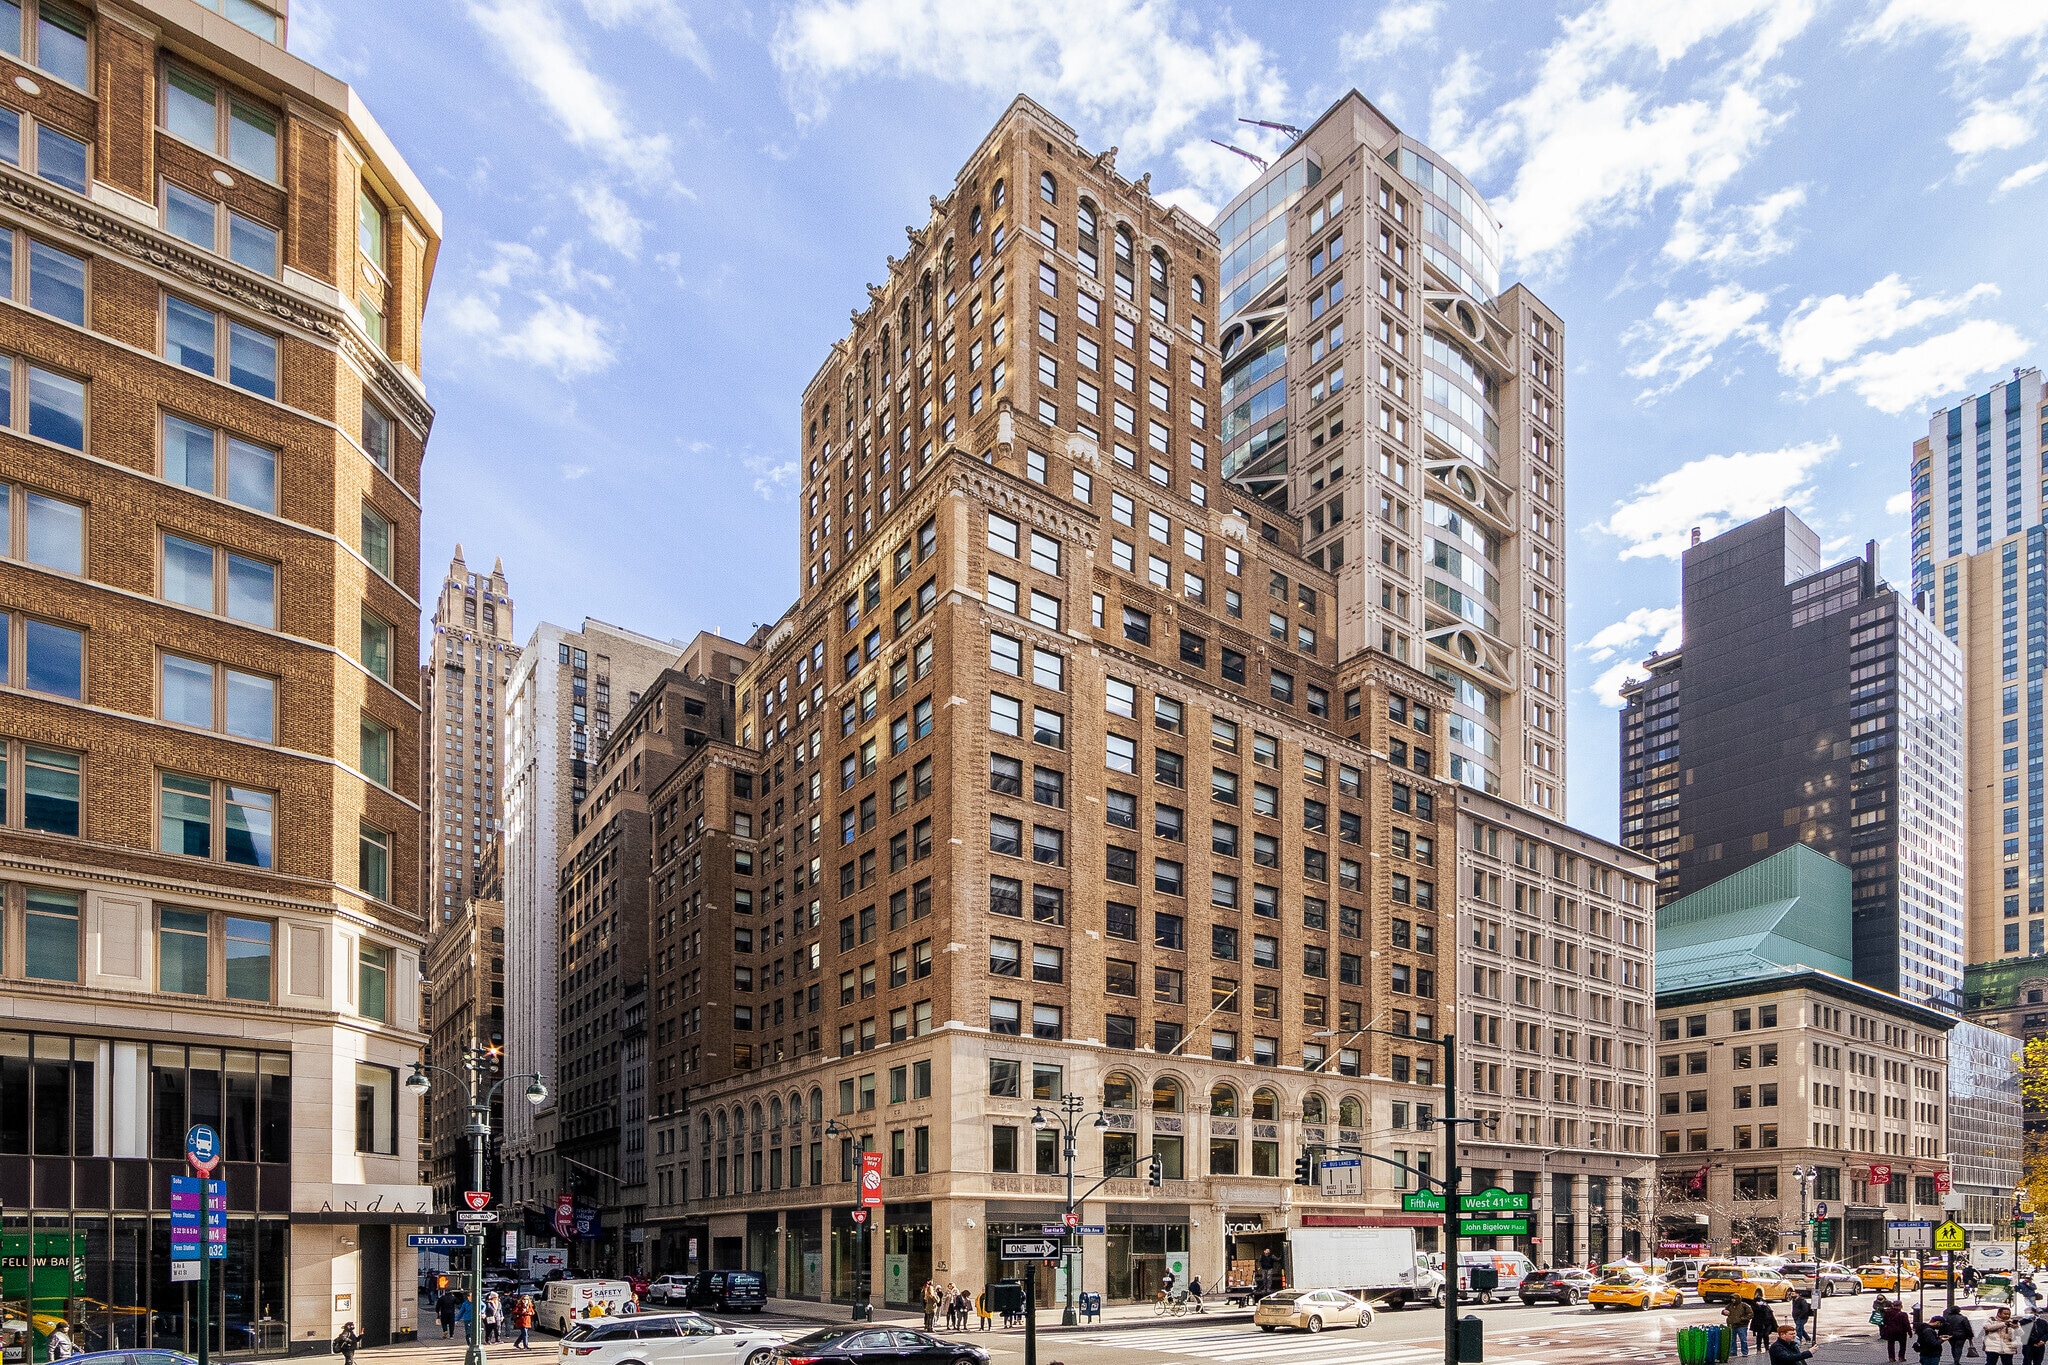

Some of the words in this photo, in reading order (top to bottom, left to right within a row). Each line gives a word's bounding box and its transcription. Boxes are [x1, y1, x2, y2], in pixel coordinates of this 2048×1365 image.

[1873, 1175, 1889, 1183] 125
[209, 1183, 218, 1193] M1
[209, 1197, 219, 1209] M1
[1410, 1199, 1426, 1208] Fifth
[1427, 1199, 1440, 1208] Ave
[1465, 1198, 1490, 1208] West
[1492, 1197, 1510, 1207] 41st
[1513, 1197, 1523, 1207] St
[209, 1214, 219, 1225] M4
[1465, 1223, 1481, 1231] John
[1482, 1222, 1510, 1232] Bigelow
[209, 1229, 219, 1241] M4
[209, 1245, 223, 1256] Q32
[1011, 1245, 1027, 1253] ONE
[1034, 1245, 1052, 1253] WAY
[2, 1258, 46, 1267] FELLW
[532, 1255, 563, 1264] FedEx
[594, 1288, 622, 1297] SAFETY
